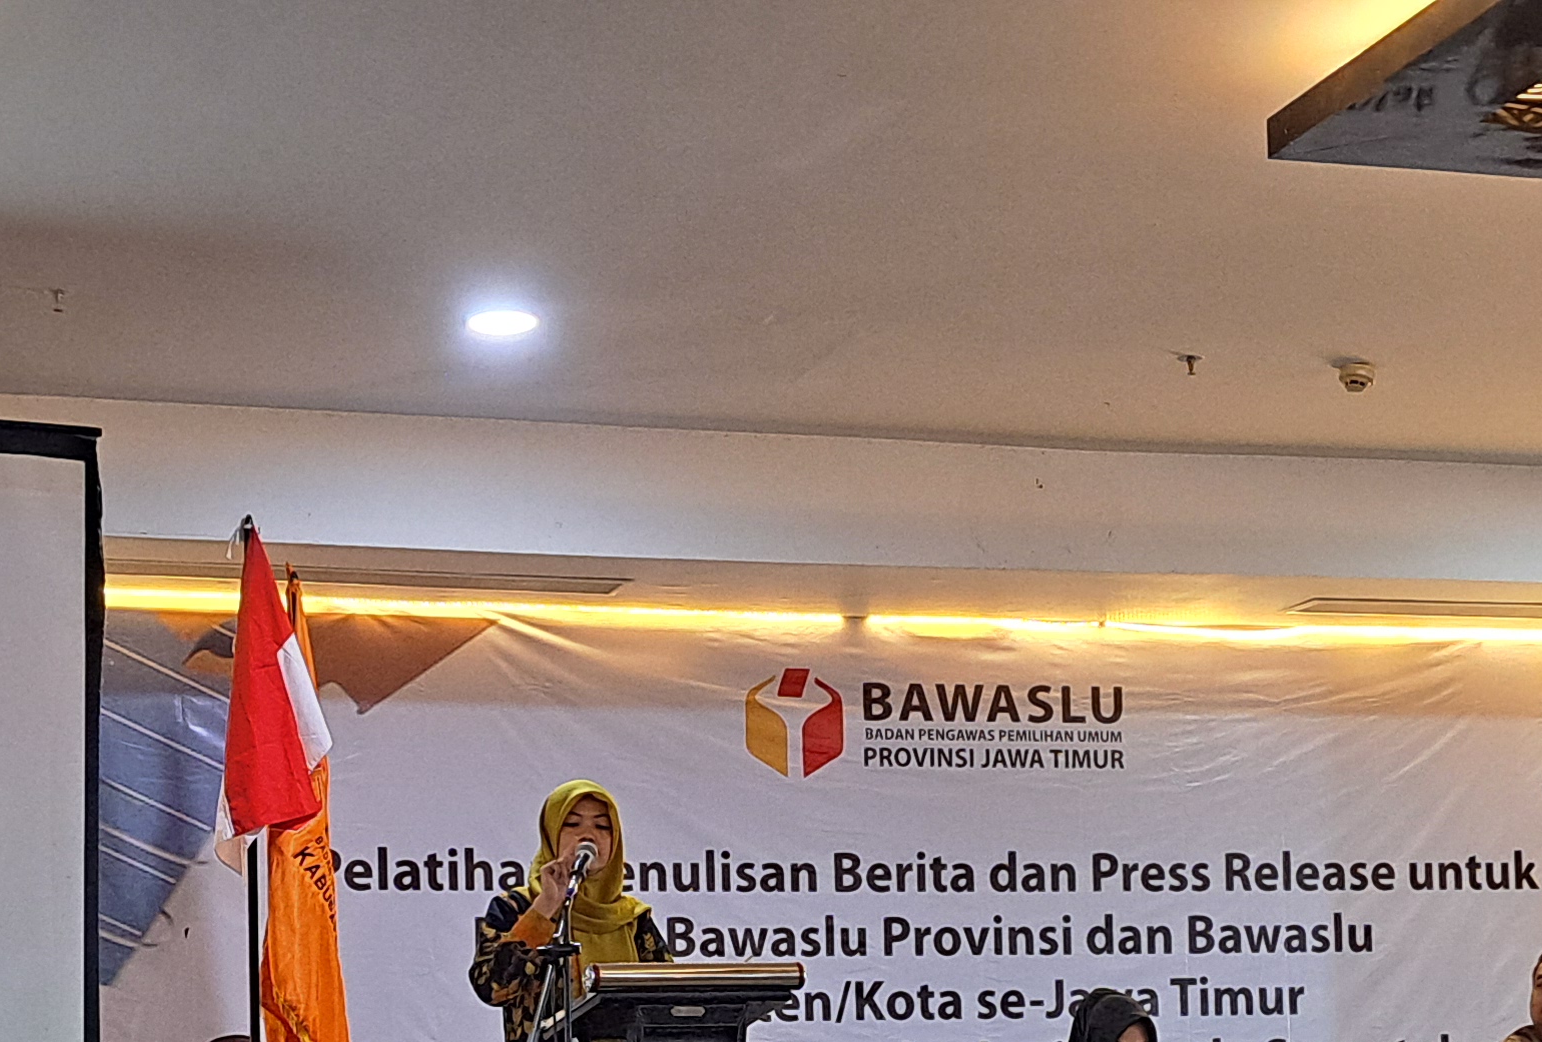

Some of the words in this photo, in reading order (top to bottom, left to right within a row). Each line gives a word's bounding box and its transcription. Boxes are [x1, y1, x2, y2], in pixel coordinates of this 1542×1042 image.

[862, 682, 1124, 724] BAWASLU
[865, 728, 915, 741] BADAN
[918, 728, 995, 742] PENGAWAS
[999, 730, 1075, 743] PEMILIHAN
[1077, 731, 1123, 743] UMUM
[863, 747, 975, 768] PROVINSI
[981, 748, 1045, 769] JAWA
[1049, 749, 1125, 769] TIMUR
[833, 851, 974, 893] Berita
[989, 851, 1077, 893] dan
[1092, 852, 1210, 892] Press
[1224, 850, 1395, 891] Release
[1409, 850, 1540, 891] untuk
[666, 915, 867, 957] Bawaslu
[883, 915, 1072, 956] Provinsi
[1086, 914, 1172, 955] dan
[1187, 912, 1374, 954] Bawaslu
[1170, 976, 1305, 1017] Timur
